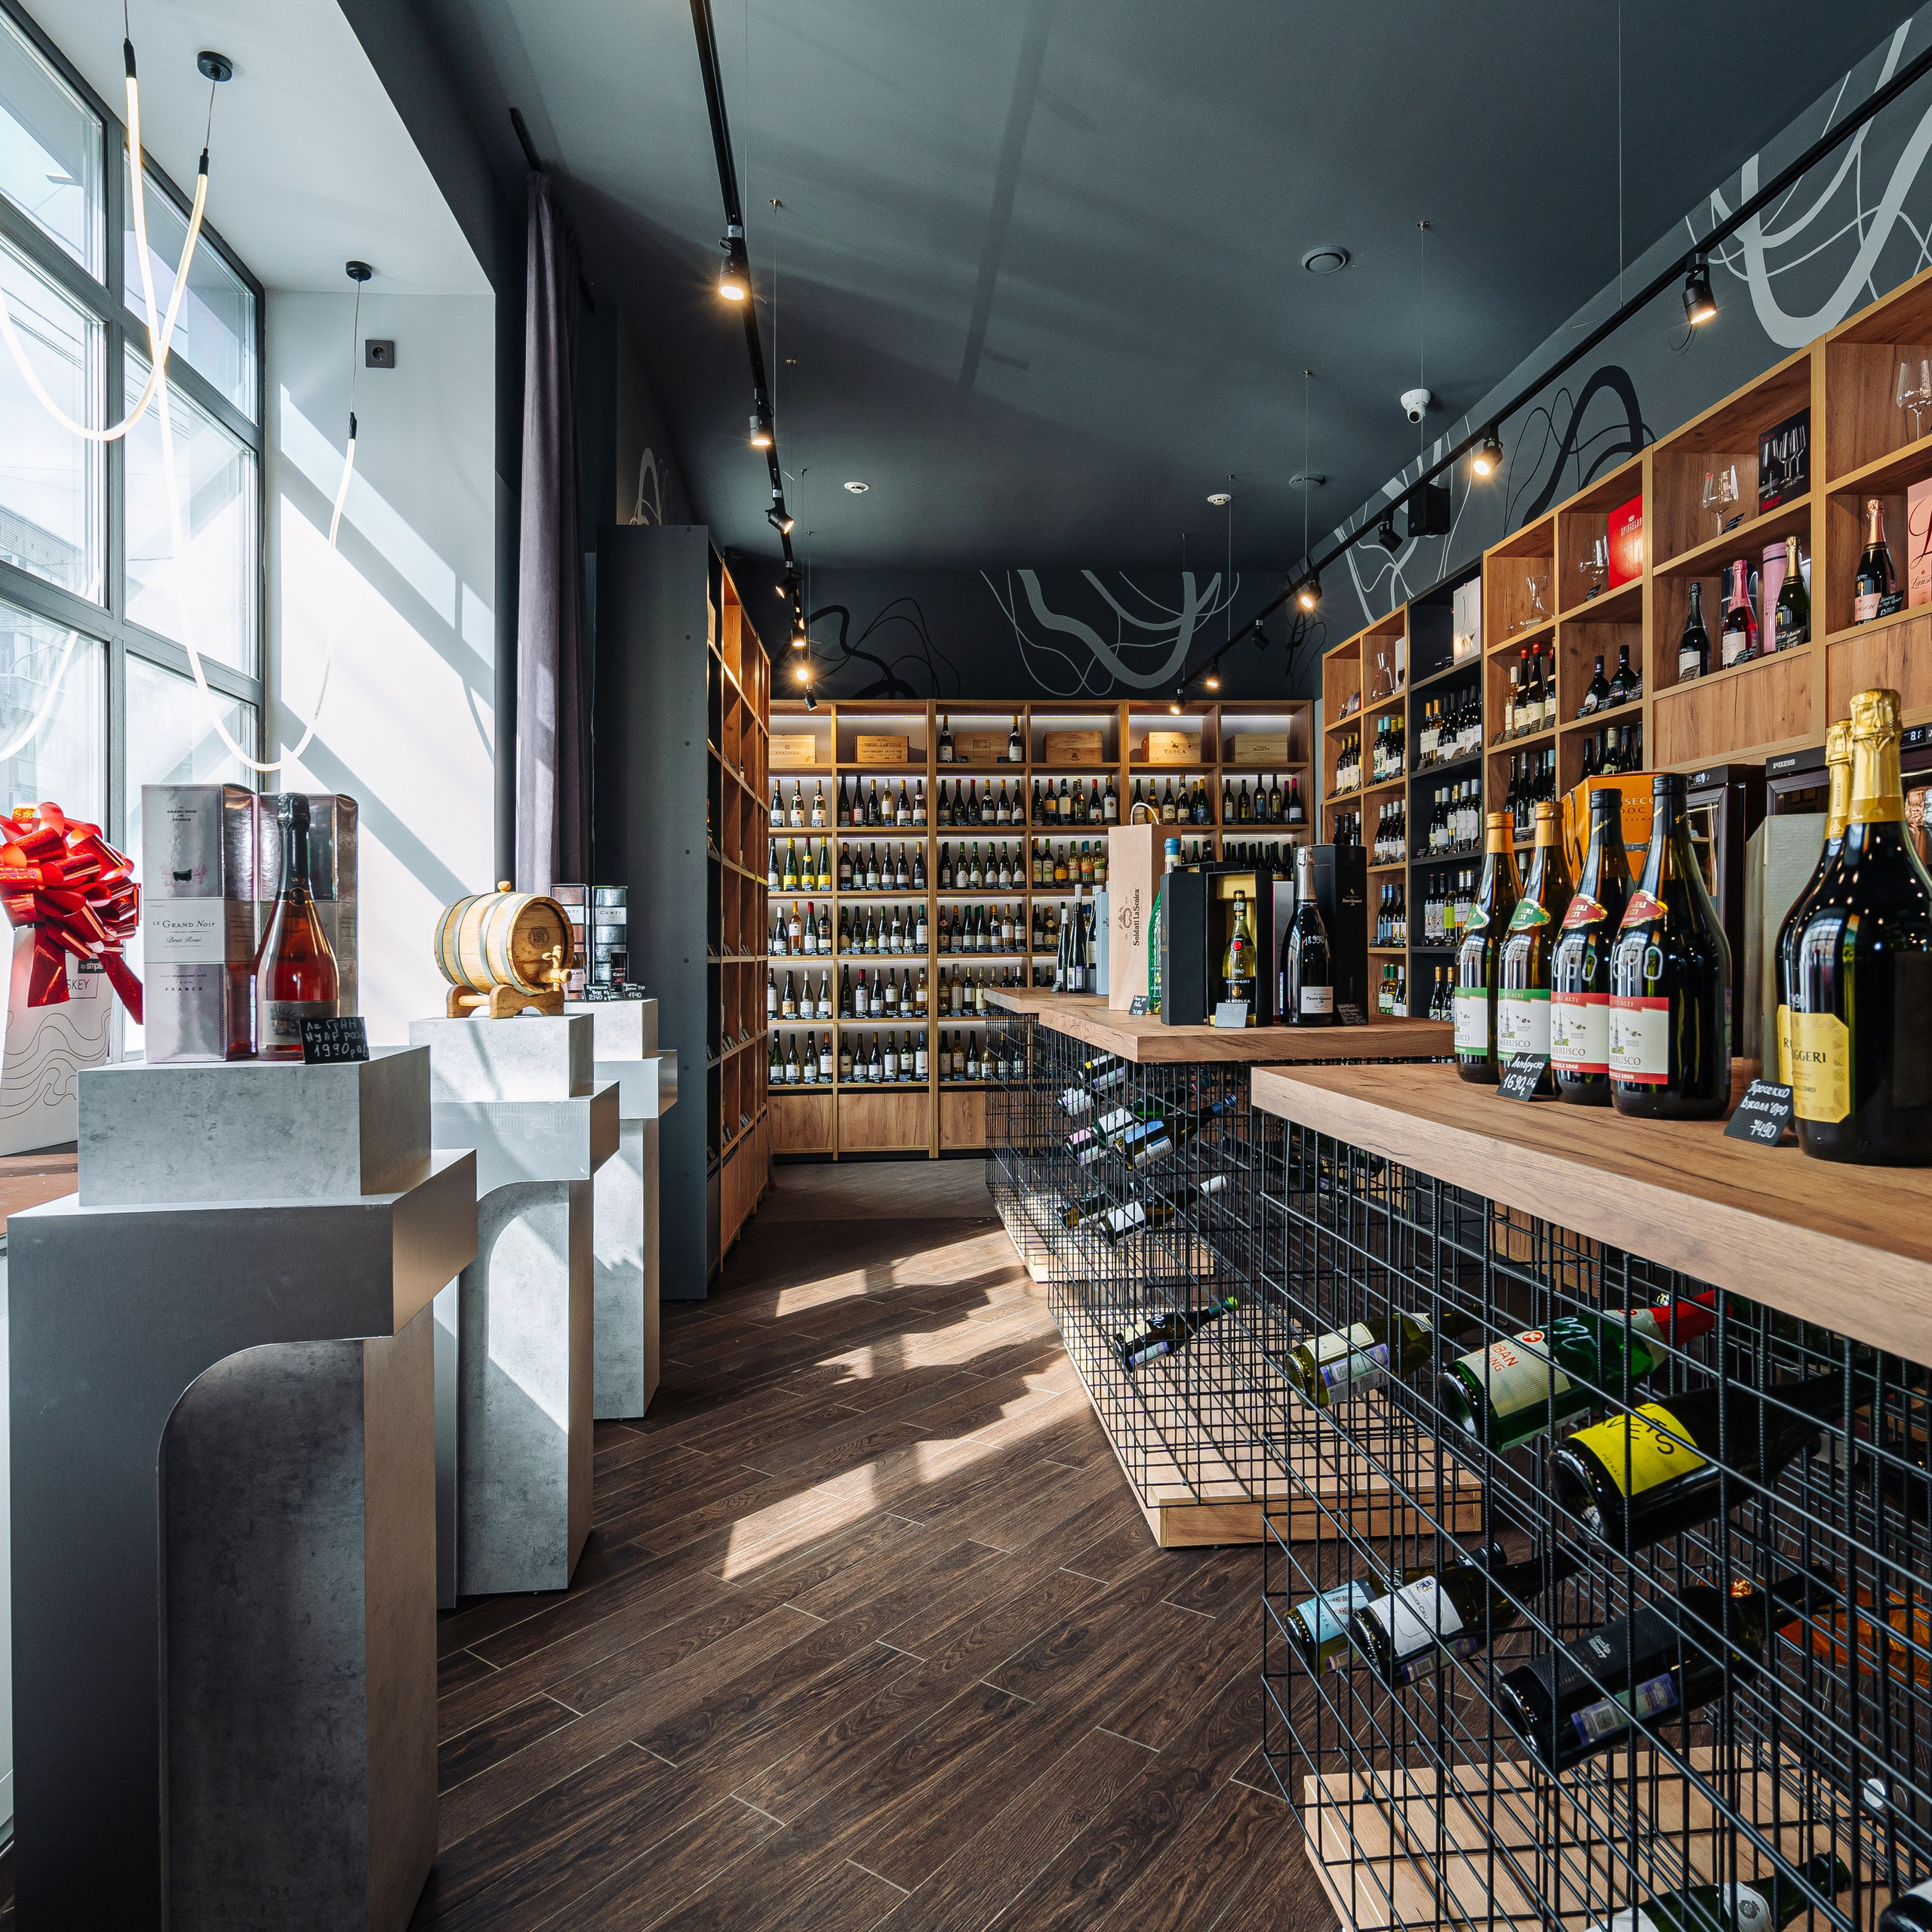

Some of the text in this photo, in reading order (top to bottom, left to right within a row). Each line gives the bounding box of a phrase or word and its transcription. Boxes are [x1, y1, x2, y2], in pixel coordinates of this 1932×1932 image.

[1773, 758, 1795, 769] POZIS
[195, 919, 216, 928] Noir
[1132, 920, 1140, 946] Soldati
[86, 961, 103, 972] simple
[67, 979, 90, 990] SKEY
[1499, 1038, 1531, 1048] MBRUSCO
[1551, 1046, 1586, 1057] MBRUSCO
[1792, 1050, 1826, 1064] GGERI
[1610, 1054, 1641, 1066] BRUSCO
[1491, 1343, 1520, 1368] RBAN
